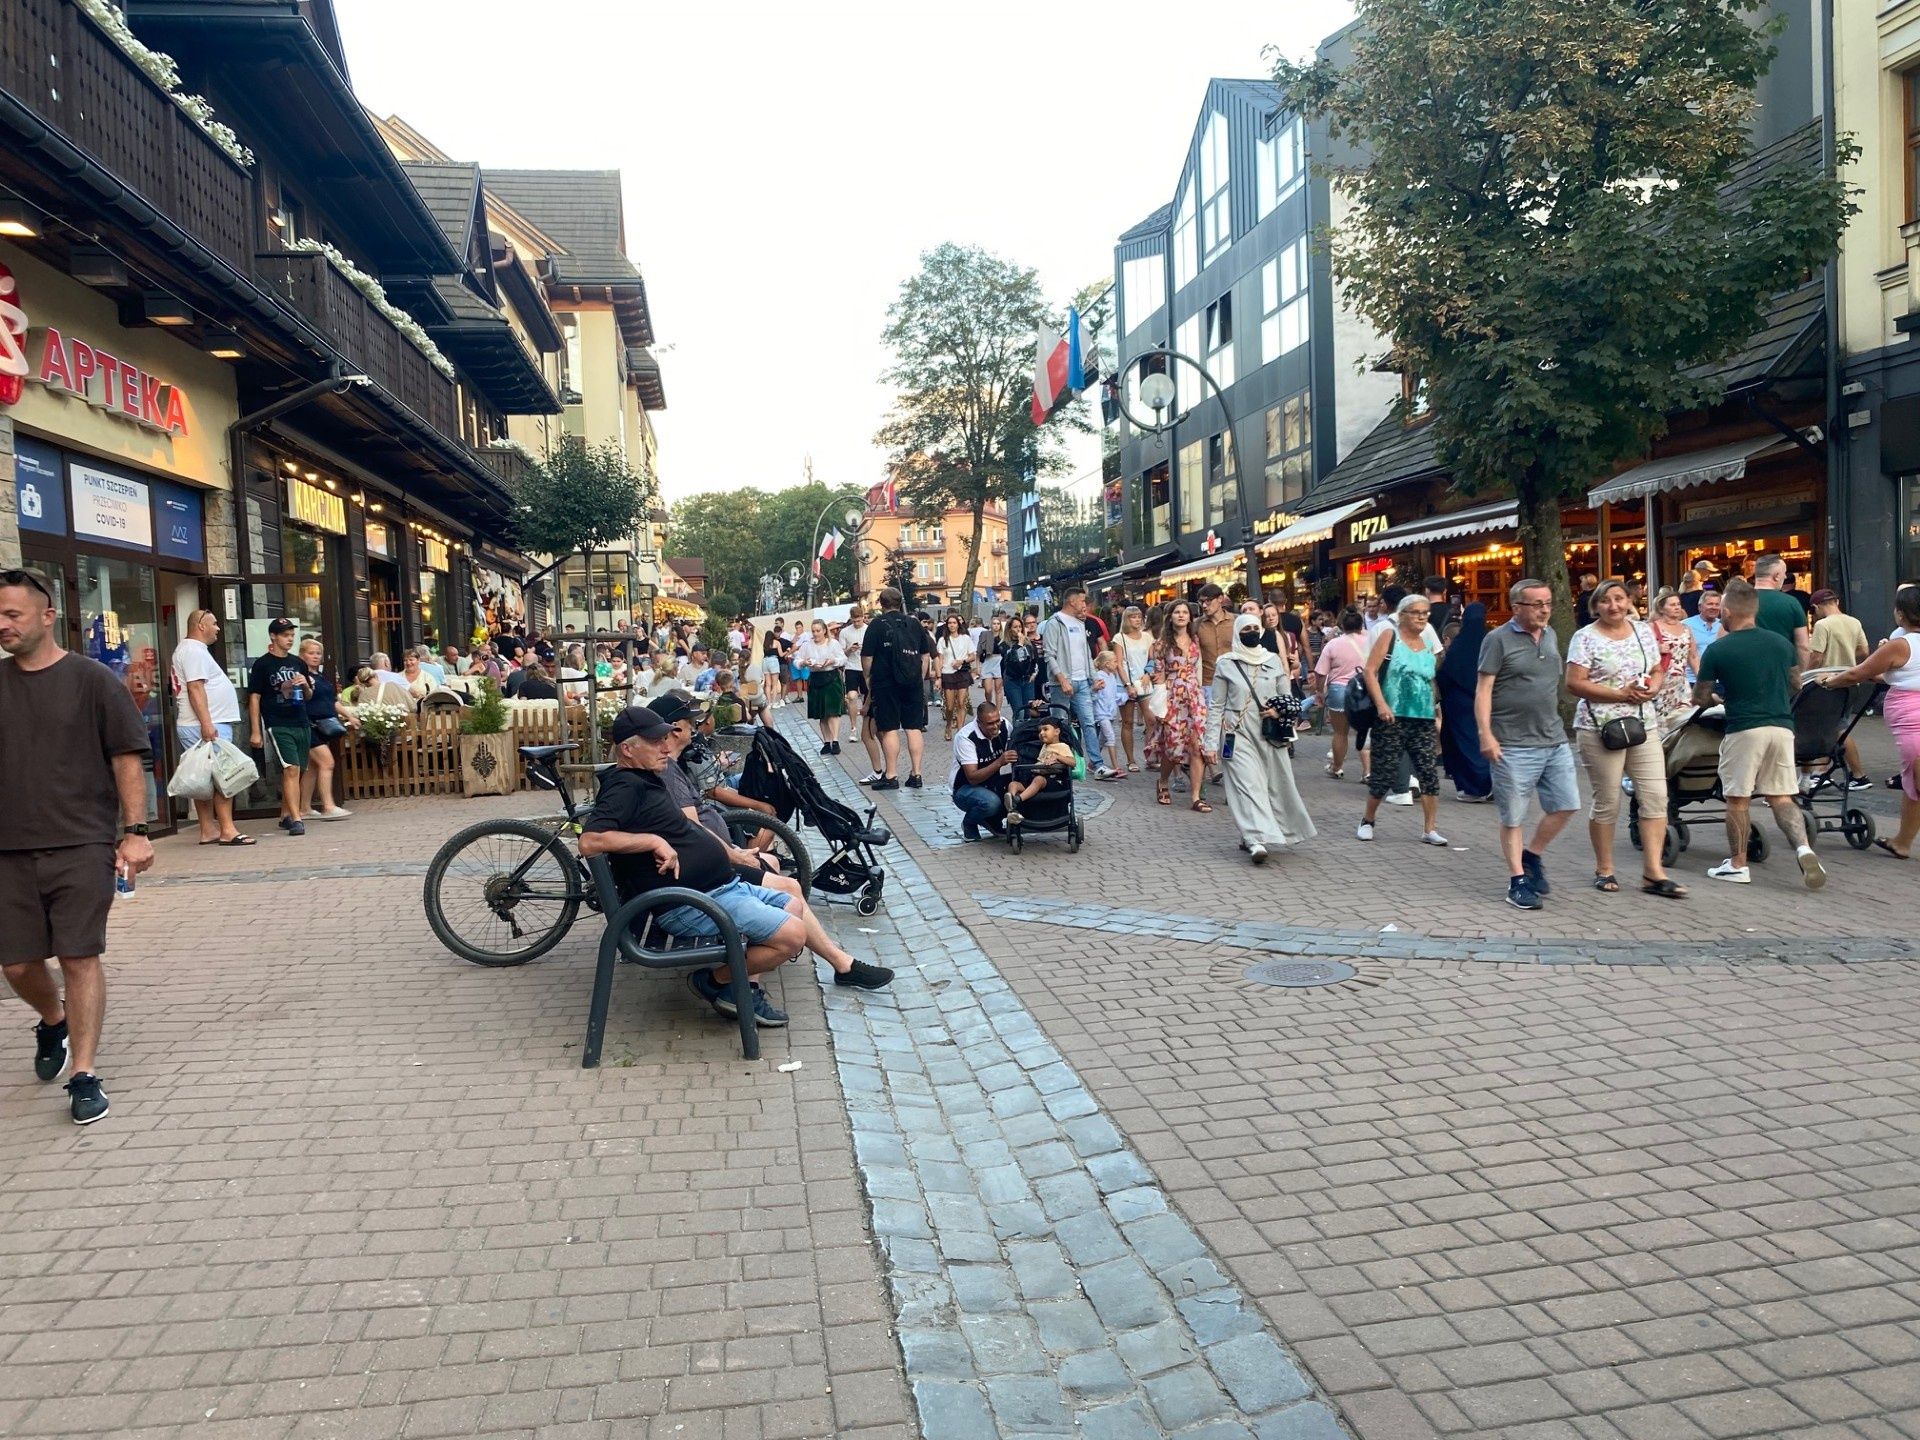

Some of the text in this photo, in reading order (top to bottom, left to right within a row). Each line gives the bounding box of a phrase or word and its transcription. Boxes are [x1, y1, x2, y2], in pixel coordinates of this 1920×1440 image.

[40, 327, 189, 436] APTEKA
[83, 473, 105, 490] PUNKT
[96, 513, 126, 529] COVID-19
[294, 479, 347, 535] KARCZMA
[1351, 514, 1388, 544] PIZZA
